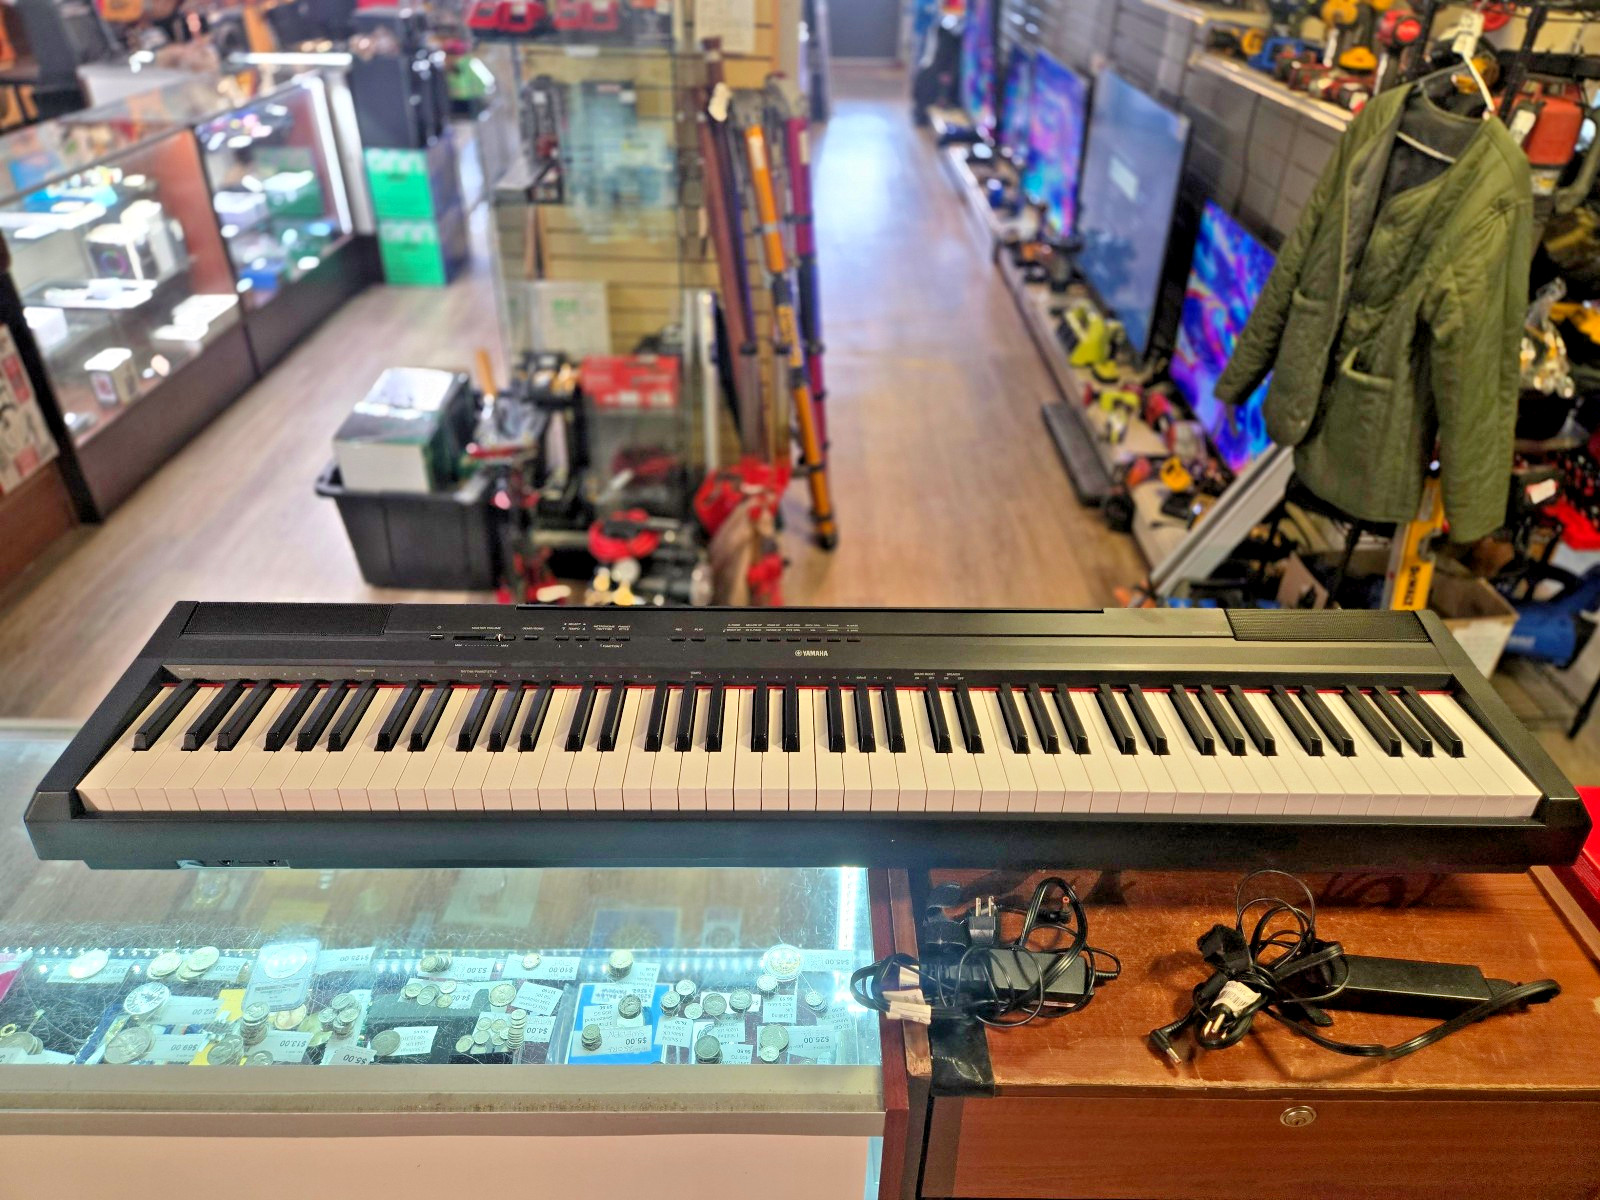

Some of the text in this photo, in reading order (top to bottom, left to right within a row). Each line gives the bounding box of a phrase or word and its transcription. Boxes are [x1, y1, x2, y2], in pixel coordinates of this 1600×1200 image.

[526, 1026, 549, 1034] $4.00
[279, 1039, 307, 1048] $13.00
[803, 1035, 830, 1044] $25.00
[342, 1053, 369, 1065] $5.00
